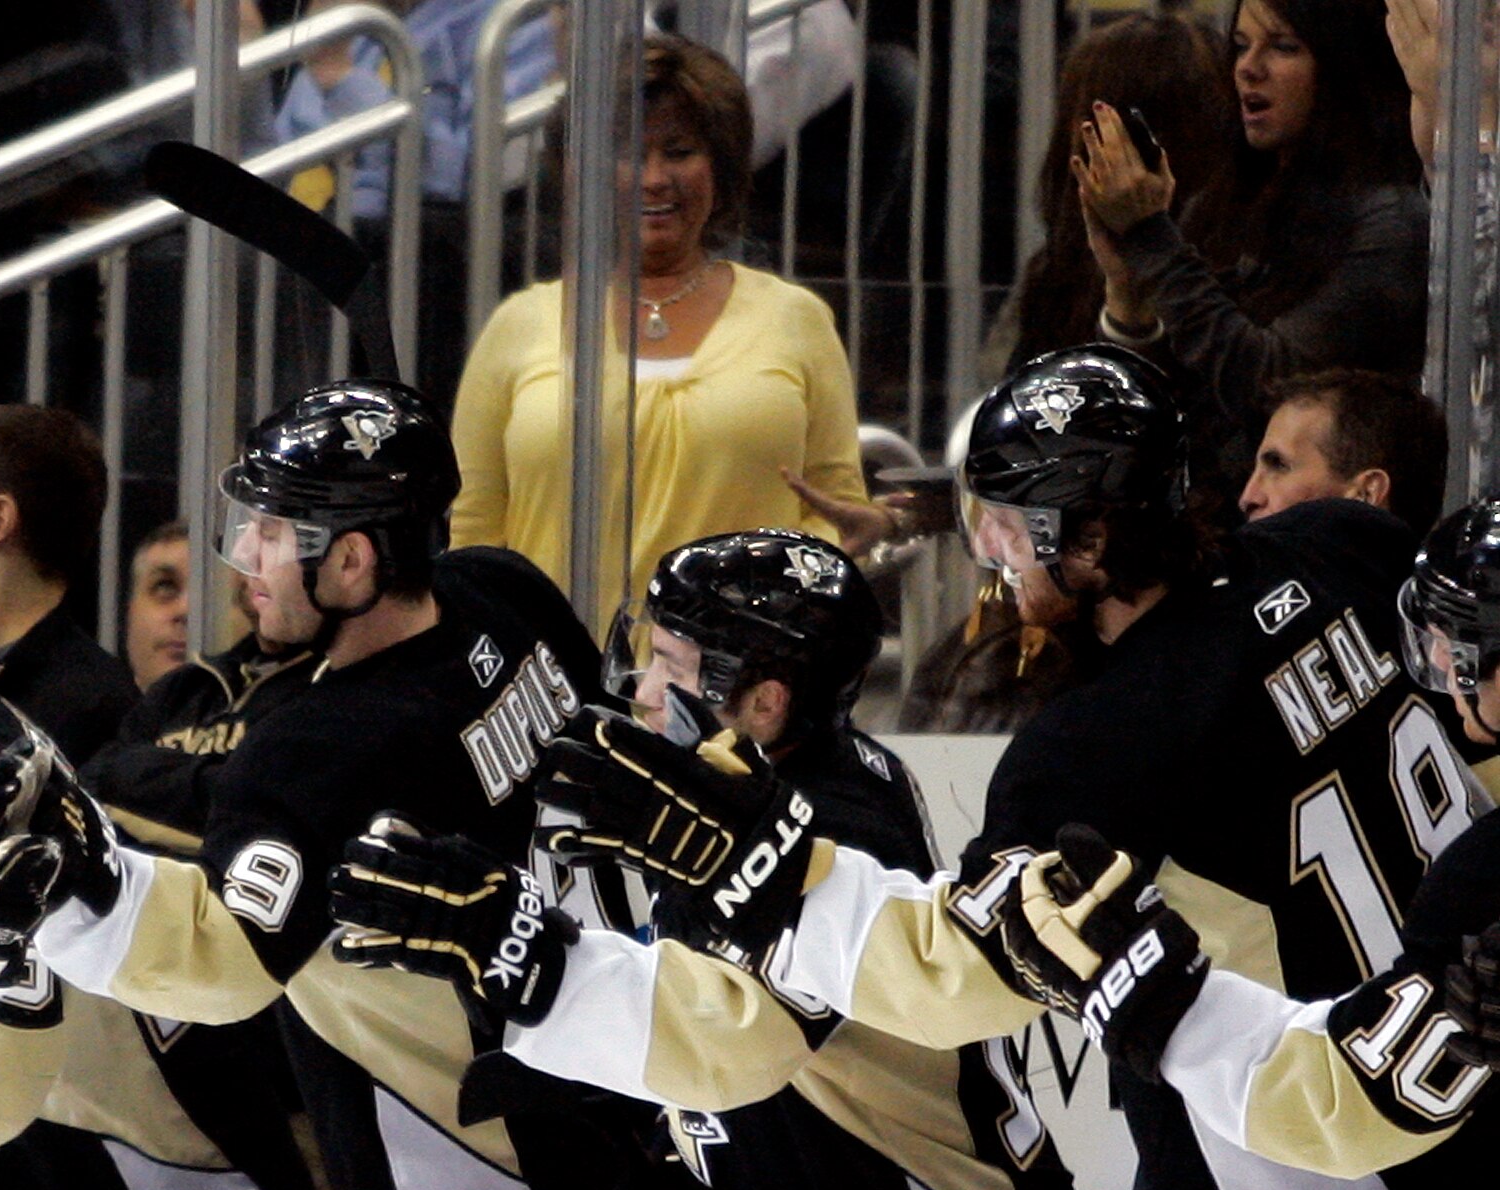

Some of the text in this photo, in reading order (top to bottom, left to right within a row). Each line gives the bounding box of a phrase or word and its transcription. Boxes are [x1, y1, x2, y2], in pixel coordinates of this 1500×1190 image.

[459, 640, 581, 807] DUPUIS
[1264, 606, 1401, 757] NEAL
[712, 790, 815, 919] STON
[1340, 973, 1493, 1124] 10
